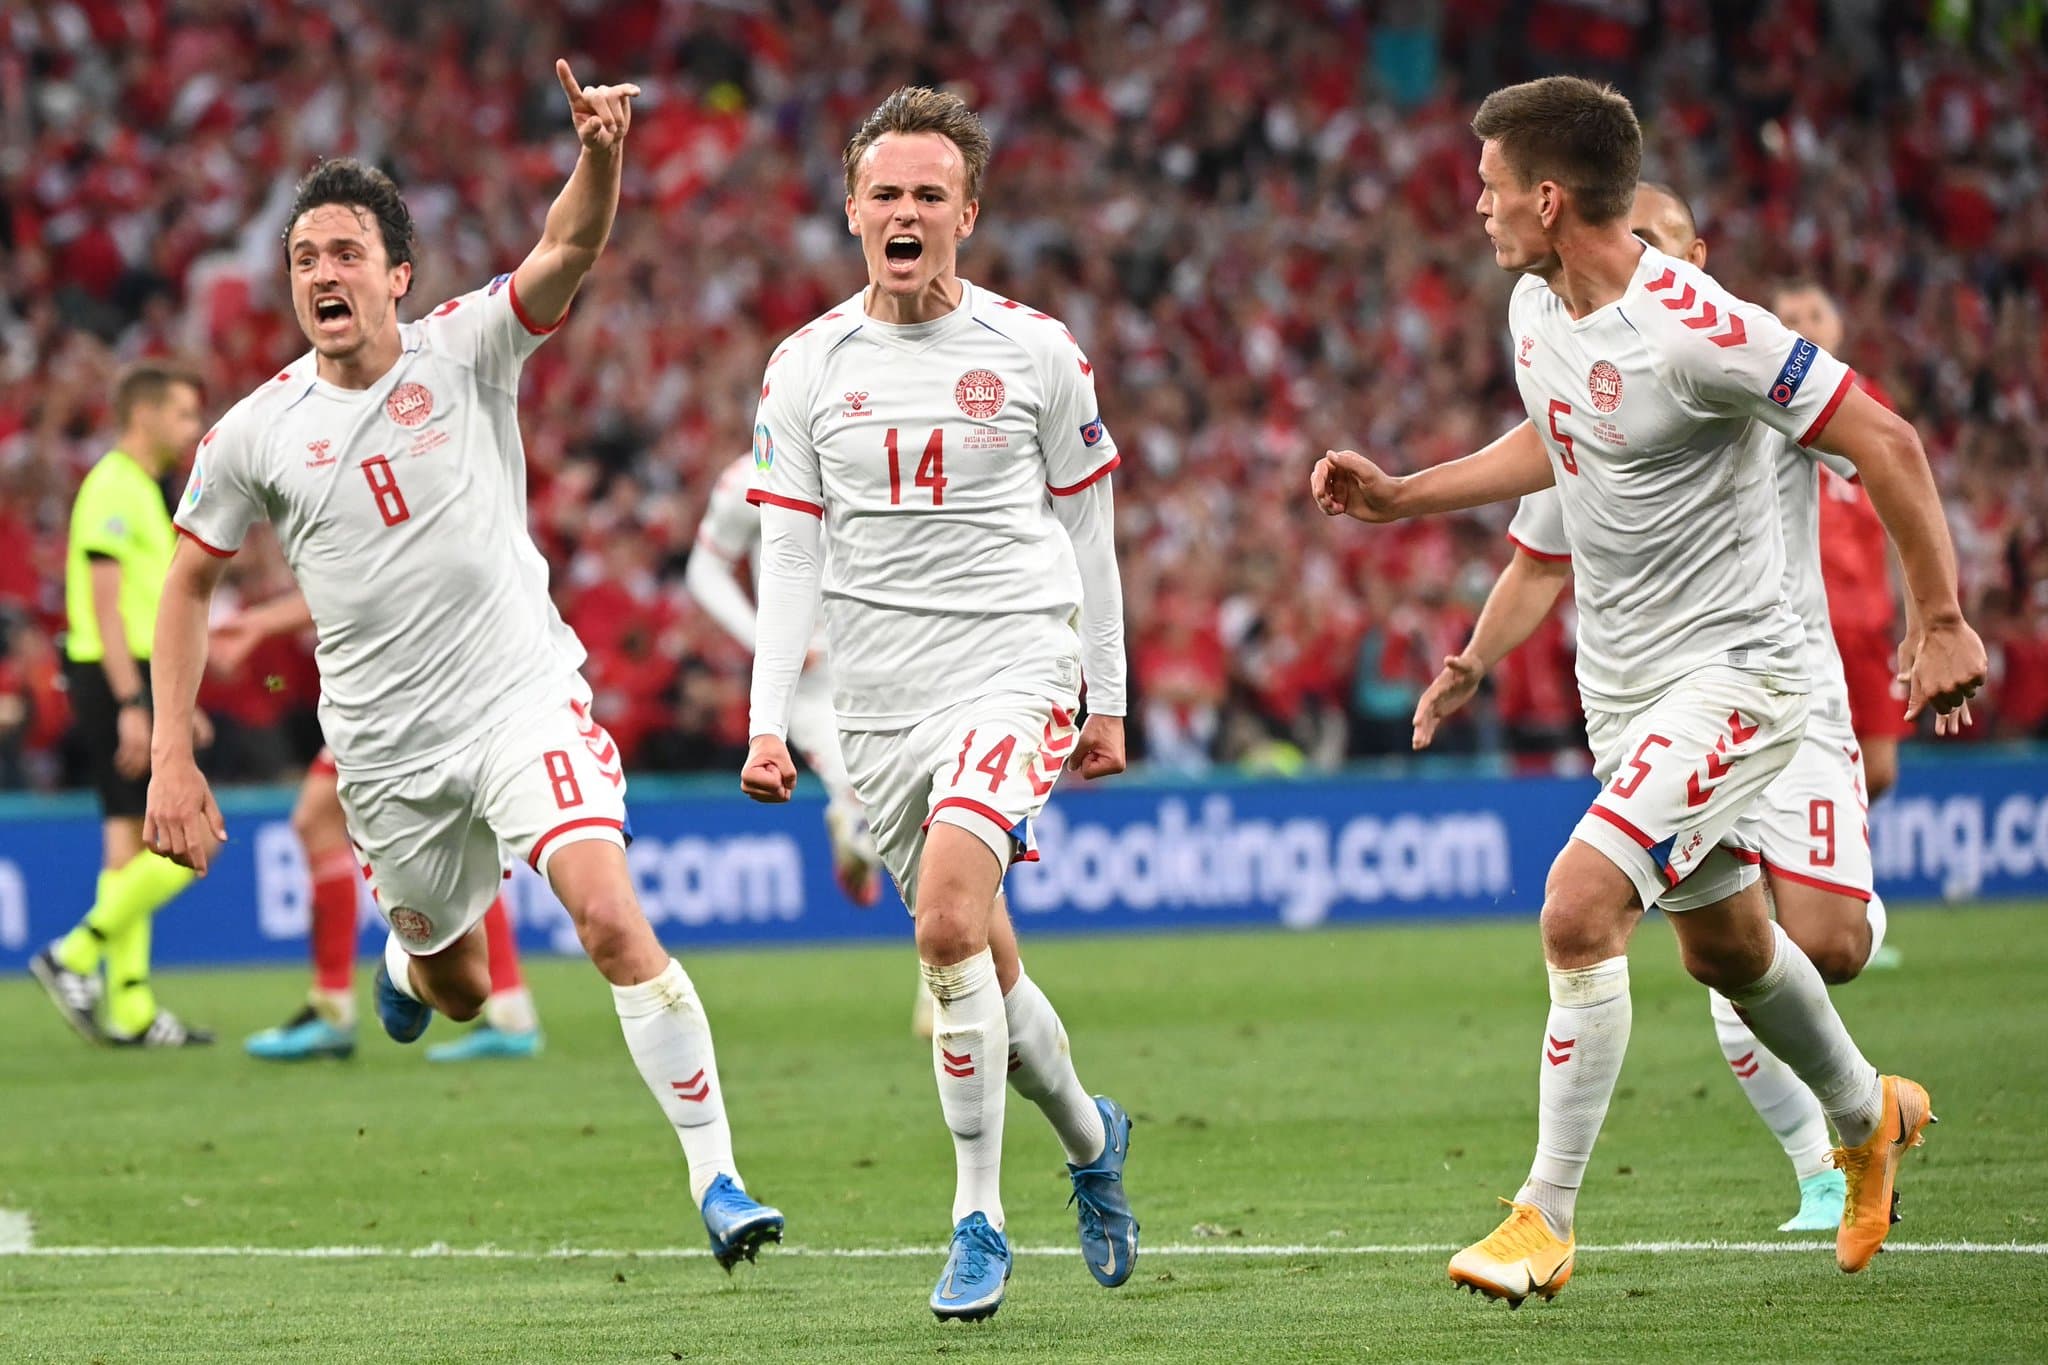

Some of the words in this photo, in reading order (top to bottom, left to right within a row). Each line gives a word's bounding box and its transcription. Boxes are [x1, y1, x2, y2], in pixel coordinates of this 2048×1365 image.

[965, 386, 996, 401] DBU
[1596, 377, 1617, 396] DBU
[1783, 341, 1813, 386] RESPECT
[395, 393, 425, 416] DBU
[1548, 398, 1578, 476] 5
[361, 454, 411, 527] 8
[883, 428, 949, 506] 14
[543, 749, 585, 810] 8
[951, 728, 1018, 795] 14
[1610, 733, 1673, 799] 5
[1809, 800, 1835, 867] 9
